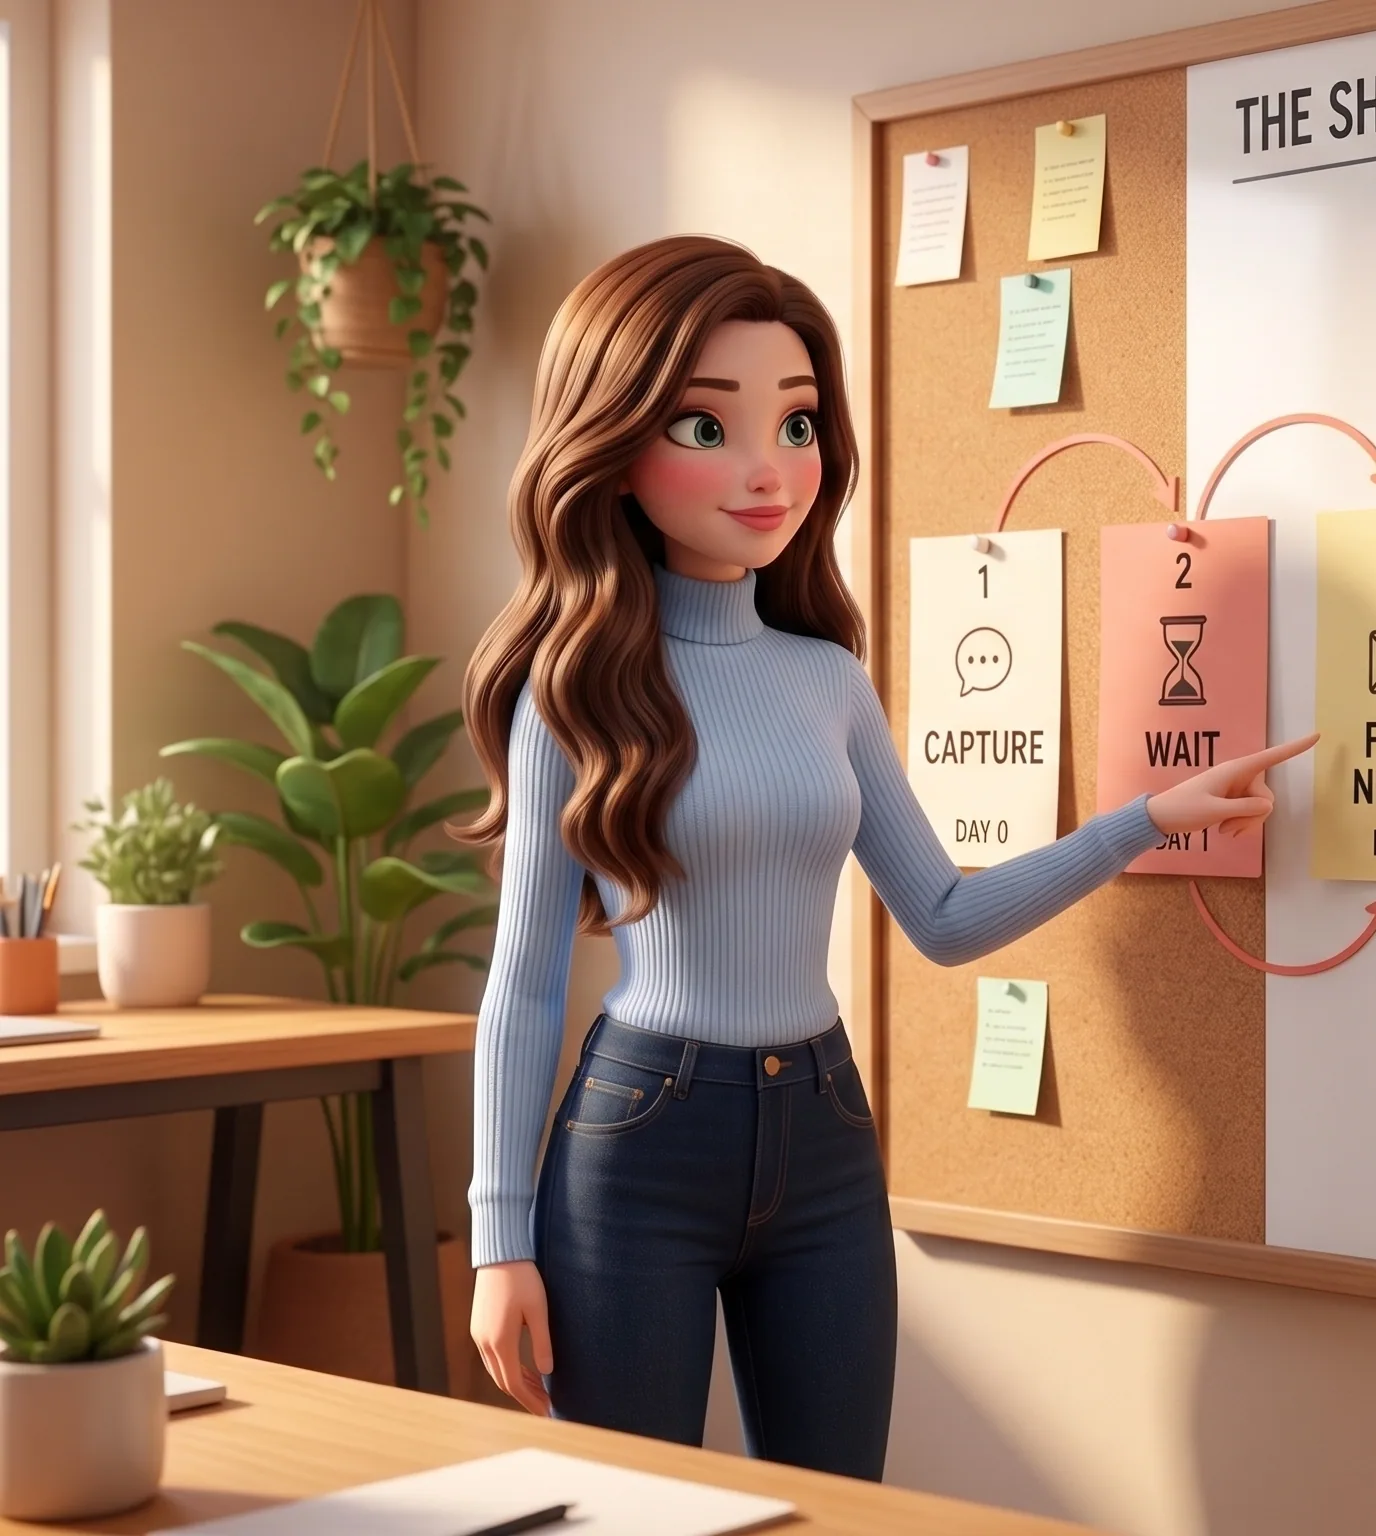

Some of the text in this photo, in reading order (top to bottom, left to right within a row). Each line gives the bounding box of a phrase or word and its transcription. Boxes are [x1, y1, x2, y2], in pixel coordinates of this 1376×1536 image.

[1235, 86, 1313, 155] THE
[977, 564, 990, 599] 1
[1174, 552, 1194, 590] 2
[924, 729, 1044, 765] CAPTURE
[1144, 730, 1221, 768] WAIT
[955, 818, 1009, 845] DAY 0
[1201, 827, 1209, 852] 1
